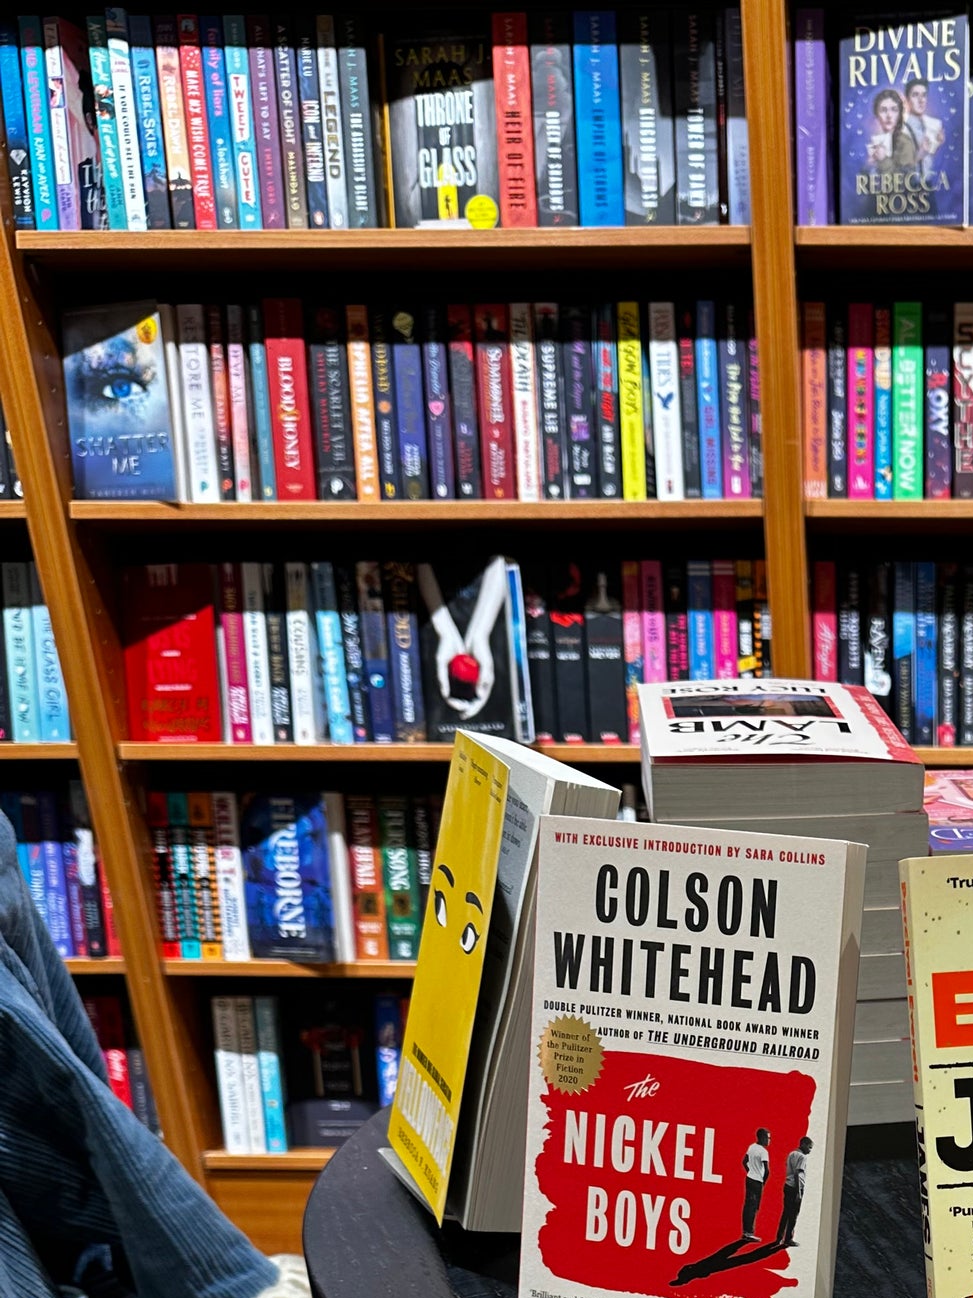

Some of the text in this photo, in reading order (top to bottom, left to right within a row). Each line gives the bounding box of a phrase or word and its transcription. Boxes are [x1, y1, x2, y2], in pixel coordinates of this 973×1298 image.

[854, 19, 956, 52] DIVINE
[849, 49, 961, 88] RIVALS
[232, 76, 247, 143] TWEET
[414, 91, 474, 127] THRONE
[185, 70, 211, 199] MAKE MY WISH COME TRUE
[323, 90, 342, 180] LEGEND
[438, 127, 452, 146] OF
[240, 155, 252, 202] CUTE
[418, 146, 478, 188] GLASS
[855, 171, 951, 196] REBECCA
[876, 193, 931, 216] ROSS
[927, 372, 949, 436] ROXY
[898, 360, 917, 492] BETTER NOW
[76, 432, 169, 458] SHATTER
[112, 456, 141, 476] ME
[669, 719, 852, 734] LAMB
[554, 832, 826, 865] WITH EXCLUSIVE INTRODUCTION BY SARA COLLINS
[595, 863, 778, 939] COLSON
[553, 931, 816, 1015] WHITEHEAD
[543, 1000, 819, 1040] DOUBLE PULITZER WINNER, NATIONAL BOOK AWARD WINNER
[551, 1029, 591, 1042] Winner of
[547, 1040, 593, 1053] the Pulitzer
[554, 1052, 585, 1063] Prize in
[597, 1026, 819, 1060] AUTHOR OF THE UNDERGROUND RAILROAD
[556, 1063, 584, 1074] Fiction
[558, 1075, 579, 1084] 2020
[624, 1074, 660, 1102] The
[563, 1109, 723, 1184] NICKEL
[585, 1186, 691, 1255] BOYS
